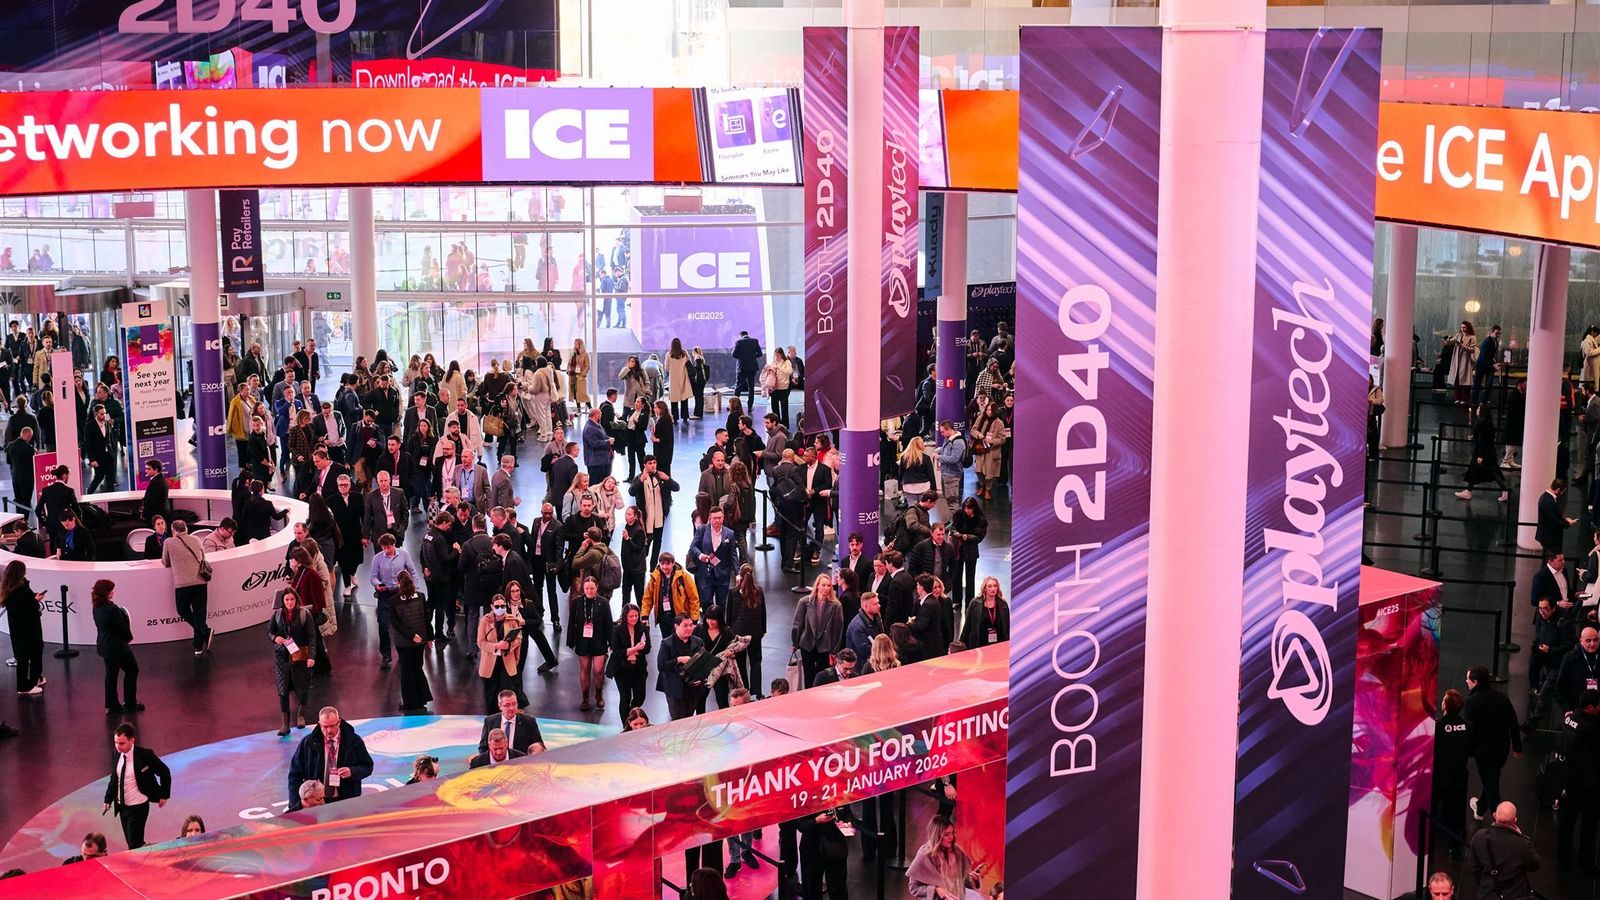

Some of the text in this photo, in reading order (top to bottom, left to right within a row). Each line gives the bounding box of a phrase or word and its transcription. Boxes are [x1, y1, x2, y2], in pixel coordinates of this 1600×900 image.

[322, 118, 442, 153] now
[504, 108, 631, 160] ICE
[721, 174, 748, 182] Seminars
[1423, 125, 1506, 192] ICE
[1519, 132, 1600, 223] Ap
[885, 127, 912, 270] playtech
[231, 228, 243, 250] Pay
[241, 199, 253, 250] Retailers
[816, 129, 835, 335] BOOTH 2D40
[659, 251, 751, 290] ICE
[687, 311, 725, 320] #ICE2025
[142, 343, 158, 351] ICE
[137, 370, 167, 379] See you
[153, 378, 170, 387] year
[1262, 277, 1345, 612] playtech
[1049, 283, 1113, 778] BOOTH 2D40
[1377, 603, 1400, 617] #ICE25
[1453, 724, 1466, 732] ICE
[711, 762, 801, 808] THANK
[808, 747, 861, 782] YOU
[868, 733, 916, 767] FOR
[790, 790, 809, 809] 19
[822, 782, 838, 801] 21
[843, 763, 912, 793] JANUARY
[915, 751, 949, 774] 2026
